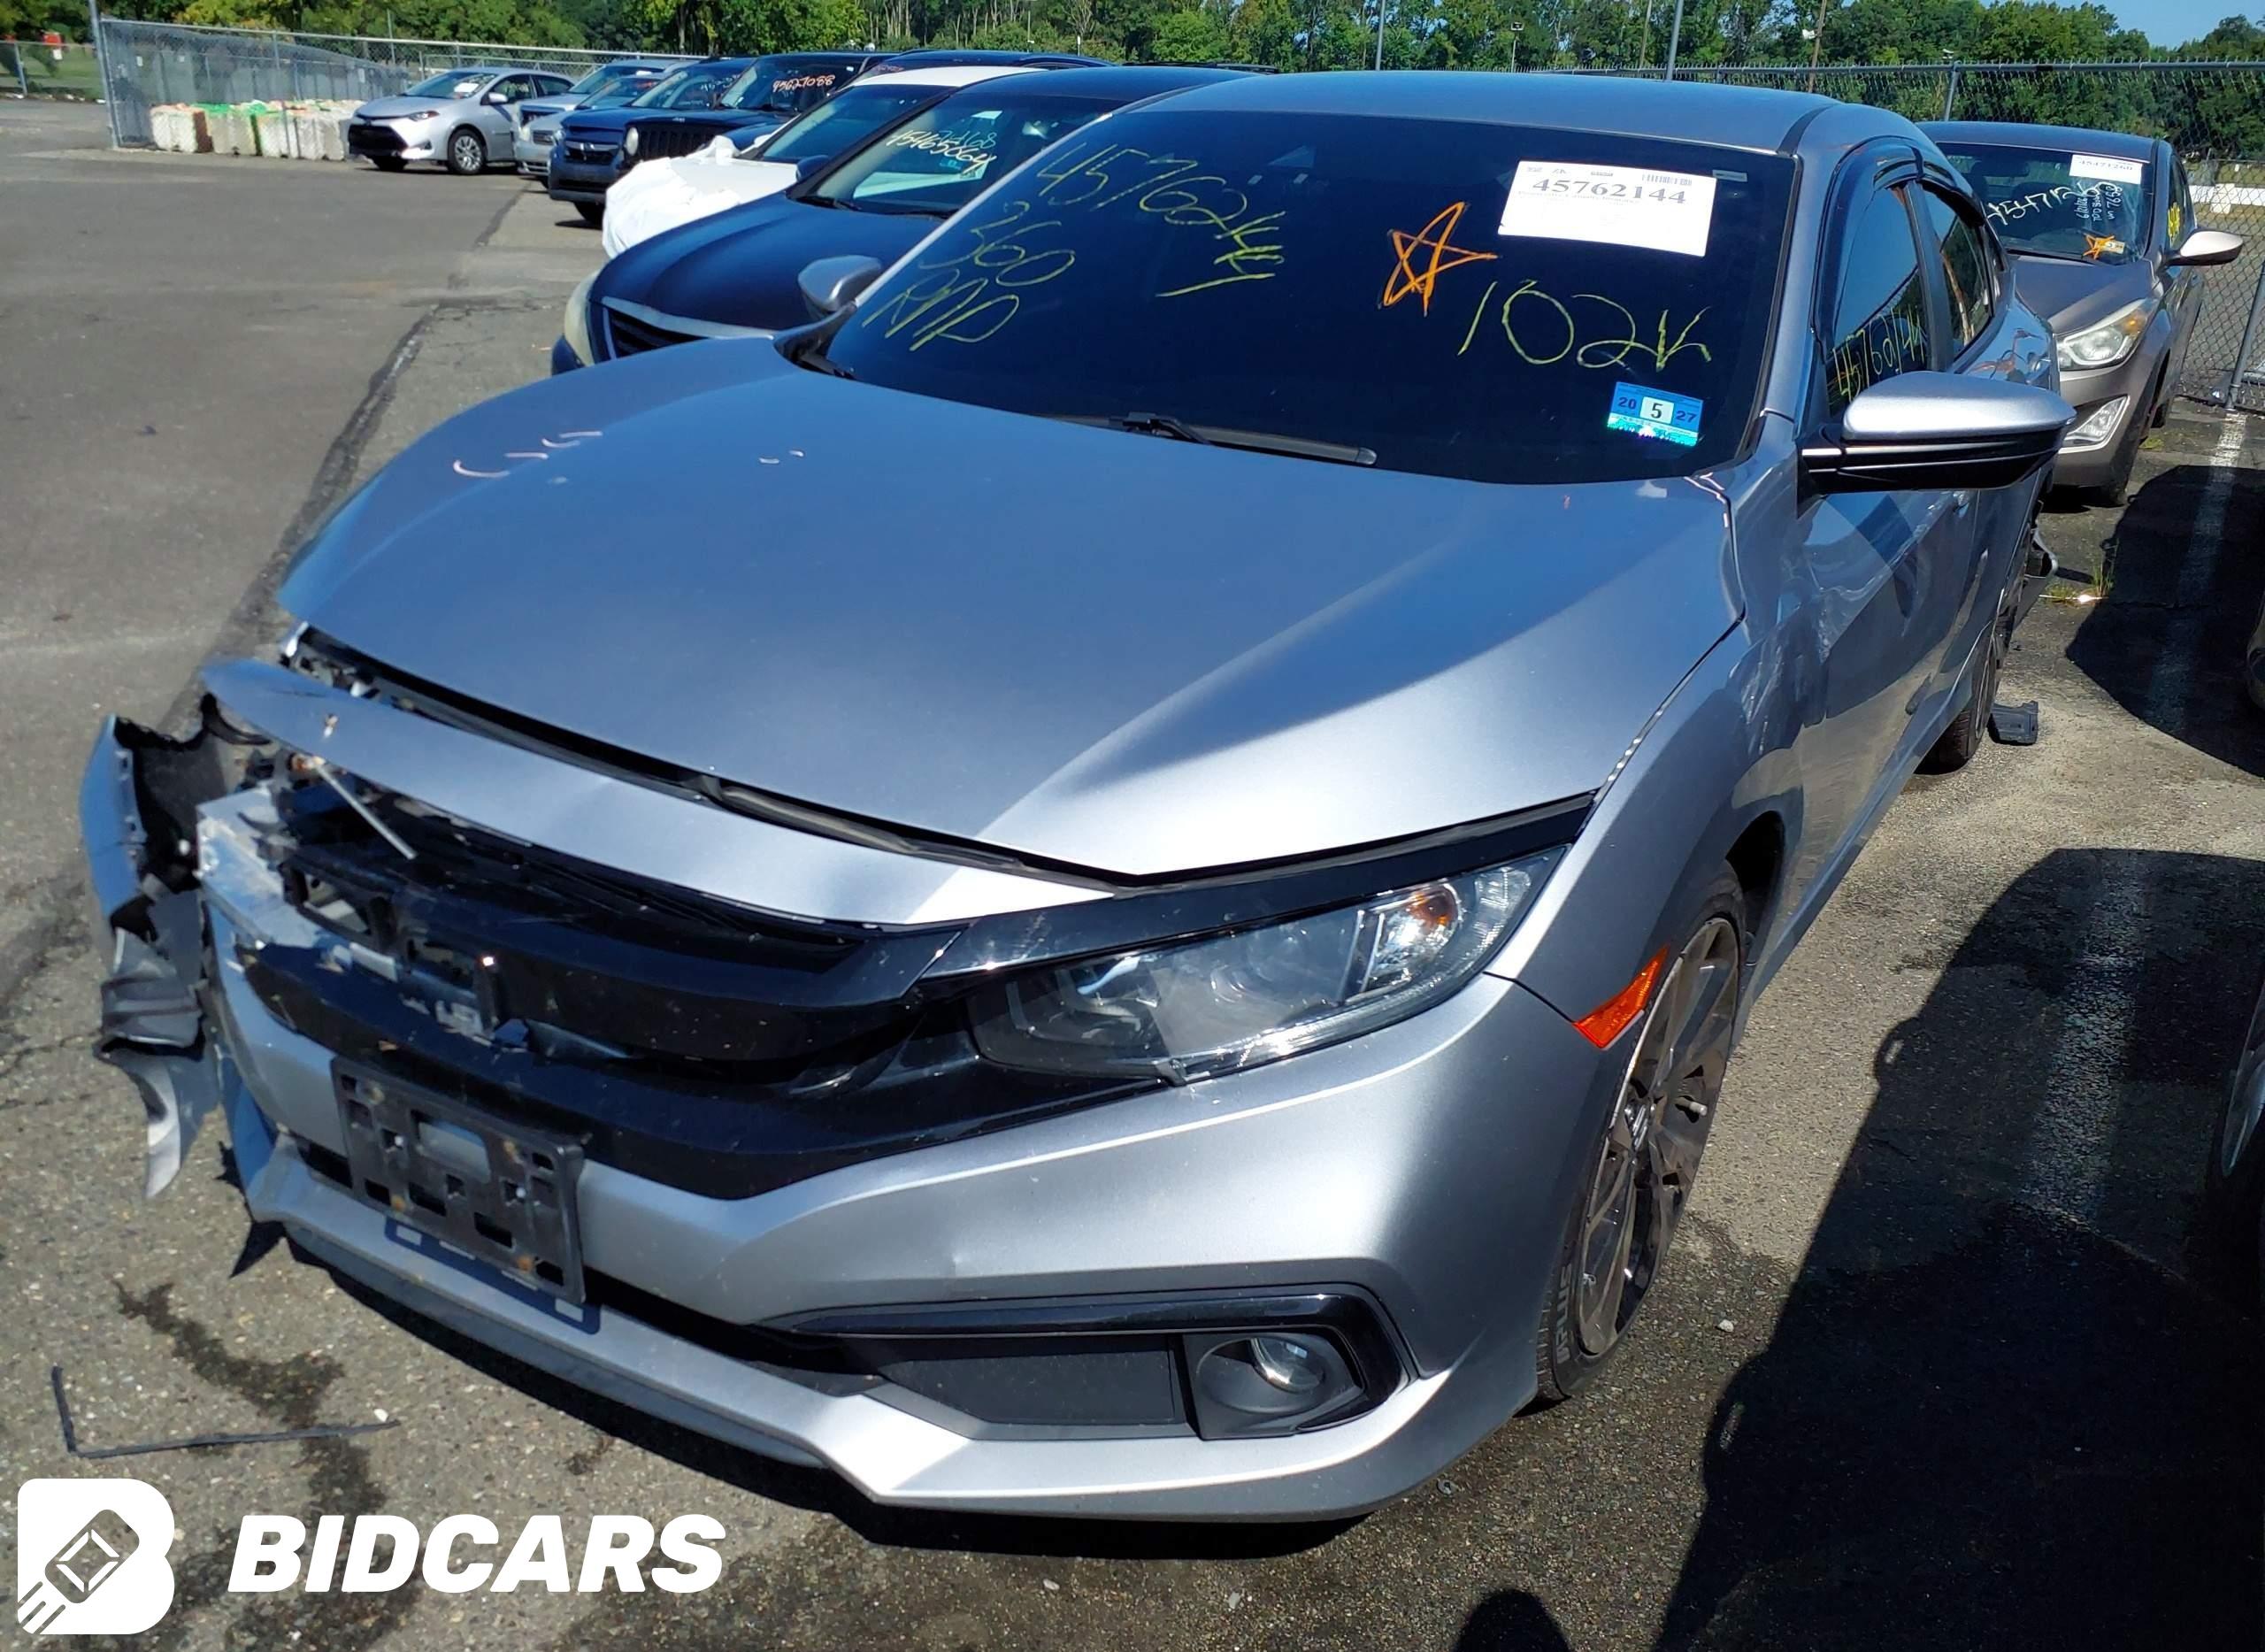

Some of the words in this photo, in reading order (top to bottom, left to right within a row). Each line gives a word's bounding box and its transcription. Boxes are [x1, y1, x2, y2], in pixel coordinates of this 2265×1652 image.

[1532, 178, 1686, 204] 45762144
[918, 200, 1077, 288] 360
[1618, 396, 1637, 411] 20
[1650, 402, 1663, 419] 5
[1676, 410, 1697, 424] 27
